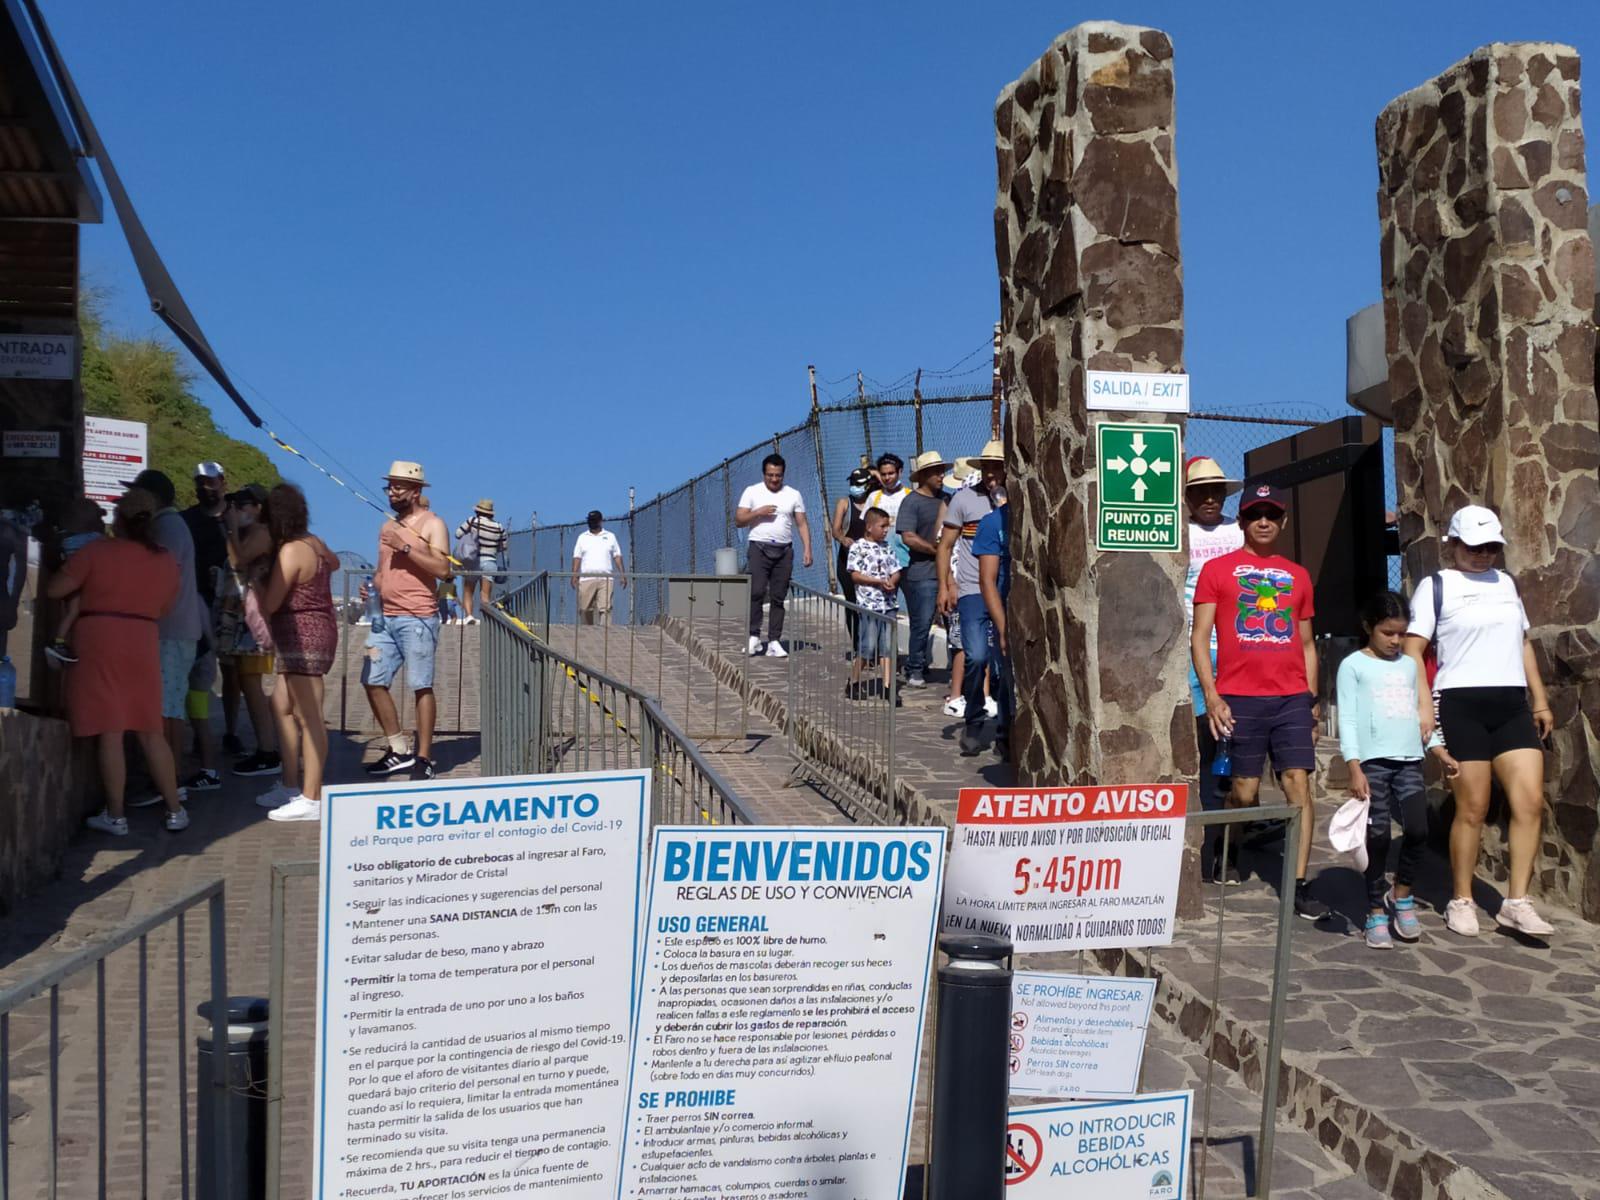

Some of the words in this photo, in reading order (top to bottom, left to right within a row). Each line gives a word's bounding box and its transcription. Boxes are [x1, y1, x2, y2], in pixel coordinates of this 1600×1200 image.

[0, 342, 66, 356] NTRADA
[1093, 380, 1141, 396] SALIDA
[1145, 382, 1148, 396] /
[1153, 383, 1182, 397] EXIT
[1104, 512, 1150, 524] PUNTO
[1154, 513, 1172, 524] DE
[1108, 527, 1169, 542] REUNIÓN
[376, 793, 599, 830] REGLAMENTO
[972, 792, 1085, 818] ATENTO
[1092, 789, 1174, 814] AVISO
[349, 835, 368, 847] del
[372, 834, 413, 846] Parque
[417, 833, 444, 845] para
[447, 829, 480, 840] evitar
[483, 827, 494, 838] el
[497, 824, 547, 838] contagio
[550, 822, 568, 834] del
[571, 819, 622, 832] Covid-19
[998, 830, 1028, 847] NUEVO
[1030, 828, 1056, 846] AVISO
[1059, 828, 1065, 845] Y
[1066, 827, 1083, 844] POR
[1085, 824, 1138, 843] DISPOSICIÓN
[1140, 824, 1171, 841] OFICIAL
[353, 862, 374, 872] Uso
[376, 857, 436, 871] obligatorio
[438, 856, 452, 866] de
[454, 853, 514, 865] cubrebocas
[516, 850, 525, 860] al
[528, 850, 568, 861] ingresar
[570, 847, 579, 856] al
[582, 846, 606, 856] Faro,
[663, 840, 931, 881] BIENVENIDOS
[353, 875, 404, 887] sanitarios
[406, 876, 413, 885] y
[415, 871, 458, 882] Mirador
[460, 869, 474, 879] de
[476, 867, 507, 878] Cristal
[1014, 855, 1122, 897] 5:45pm
[352, 897, 386, 912] Seguir
[388, 897, 402, 906] las
[405, 893, 469, 905] indicaciones
[471, 893, 478, 902] y
[480, 887, 539, 901] sugerencias
[541, 884, 557, 895] del
[559, 880, 602, 895] personal
[676, 886, 736, 900] REGLAS
[740, 886, 761, 900] DE
[765, 886, 796, 899] USO
[800, 886, 810, 899] Y
[813, 885, 912, 899] CONVIVENCIA
[956, 897, 967, 905] LA
[970, 898, 995, 909] HORA
[998, 899, 1025, 911] LÍMITE
[1050, 898, 1086, 910] INGRESAR
[1088, 898, 1097, 907] AL
[1099, 897, 1120, 906] FARO
[1122, 895, 1164, 905] MAZATLÁN
[657, 916, 690, 933] USO
[695, 915, 768, 932] GENERAL
[945, 914, 962, 928] ¡EN
[965, 916, 976, 930] LA
[980, 918, 1011, 939] NUEVA
[1015, 923, 1073, 941] NORMALIDAD
[1076, 924, 1081, 937] A
[1084, 920, 1133, 938] CUIDARNOS
[1137, 918, 1166, 935] TODOS!
[664, 936, 683, 946] Este
[736, 935, 760, 945] 100%
[763, 935, 783, 945] libre
[785, 935, 797, 944] de
[799, 935, 827, 944] humo.
[351, 954, 381, 964] Evitar
[383, 950, 422, 962] saludar
[424, 948, 438, 958] de
[440, 947, 468, 957] beso,
[470, 945, 500, 954] mano
[502, 944, 508, 954] y
[510, 940, 544, 951] abrazo
[663, 948, 697, 958] Coloca
[699, 948, 708, 958] la
[709, 948, 740, 958] basura
[756, 949, 767, 957] su
[768, 947, 794, 959] lugar.
[661, 961, 678, 971] Los
[679, 961, 714, 970] dueños
[715, 960, 727, 970] de
[729, 960, 772, 969] mascotas
[774, 959, 811, 968] deberán
[812, 960, 849, 970] recoger
[866, 957, 892, 967] heces
[1016, 984, 1031, 994] SE
[1034, 986, 1083, 998] PROHÍBE
[1086, 990, 1143, 1001] INGRESAR:
[1037, 999, 1067, 1008] allowed
[1069, 1001, 1097, 1010] beyond
[1035, 1015, 1076, 1025] Alimentos
[1078, 1018, 1083, 1026] y
[1031, 1036, 1062, 1046] Bebidas
[1027, 1058, 1053, 1068] Perros
[1056, 1060, 1069, 1068] SIN
[638, 1092, 659, 1108] SE
[664, 1089, 735, 1107] PROHIBE
[645, 1113, 669, 1122] Traer
[671, 1114, 701, 1124] perros
[703, 1111, 719, 1121] SIN
[1049, 1122, 1073, 1138] NO
[1080, 1112, 1176, 1135] INTRODUCIR
[347, 1132, 401, 1146] terminado
[404, 1131, 416, 1139] su
[418, 1126, 448, 1138] visita.
[644, 1126, 653, 1135] El
[655, 1124, 710, 1135] ambulantaje
[712, 1123, 730, 1134] y/o
[731, 1122, 774, 1132] comercio
[1078, 1133, 1144, 1154] BEBIDAS
[1050, 1151, 1169, 1177] ALCOHÓLICAS
[345, 1184, 397, 1200] Recuerda,
[399, 1180, 414, 1191] TU
[416, 1171, 486, 1189] APORTACIÓN
[488, 1172, 499, 1180] es
[502, 1169, 510, 1178] la
[513, 1164, 539, 1177] única
[542, 1162, 574, 1173] fuente
[576, 1159, 589, 1168] de
[1149, 1187, 1172, 1196] FARO
